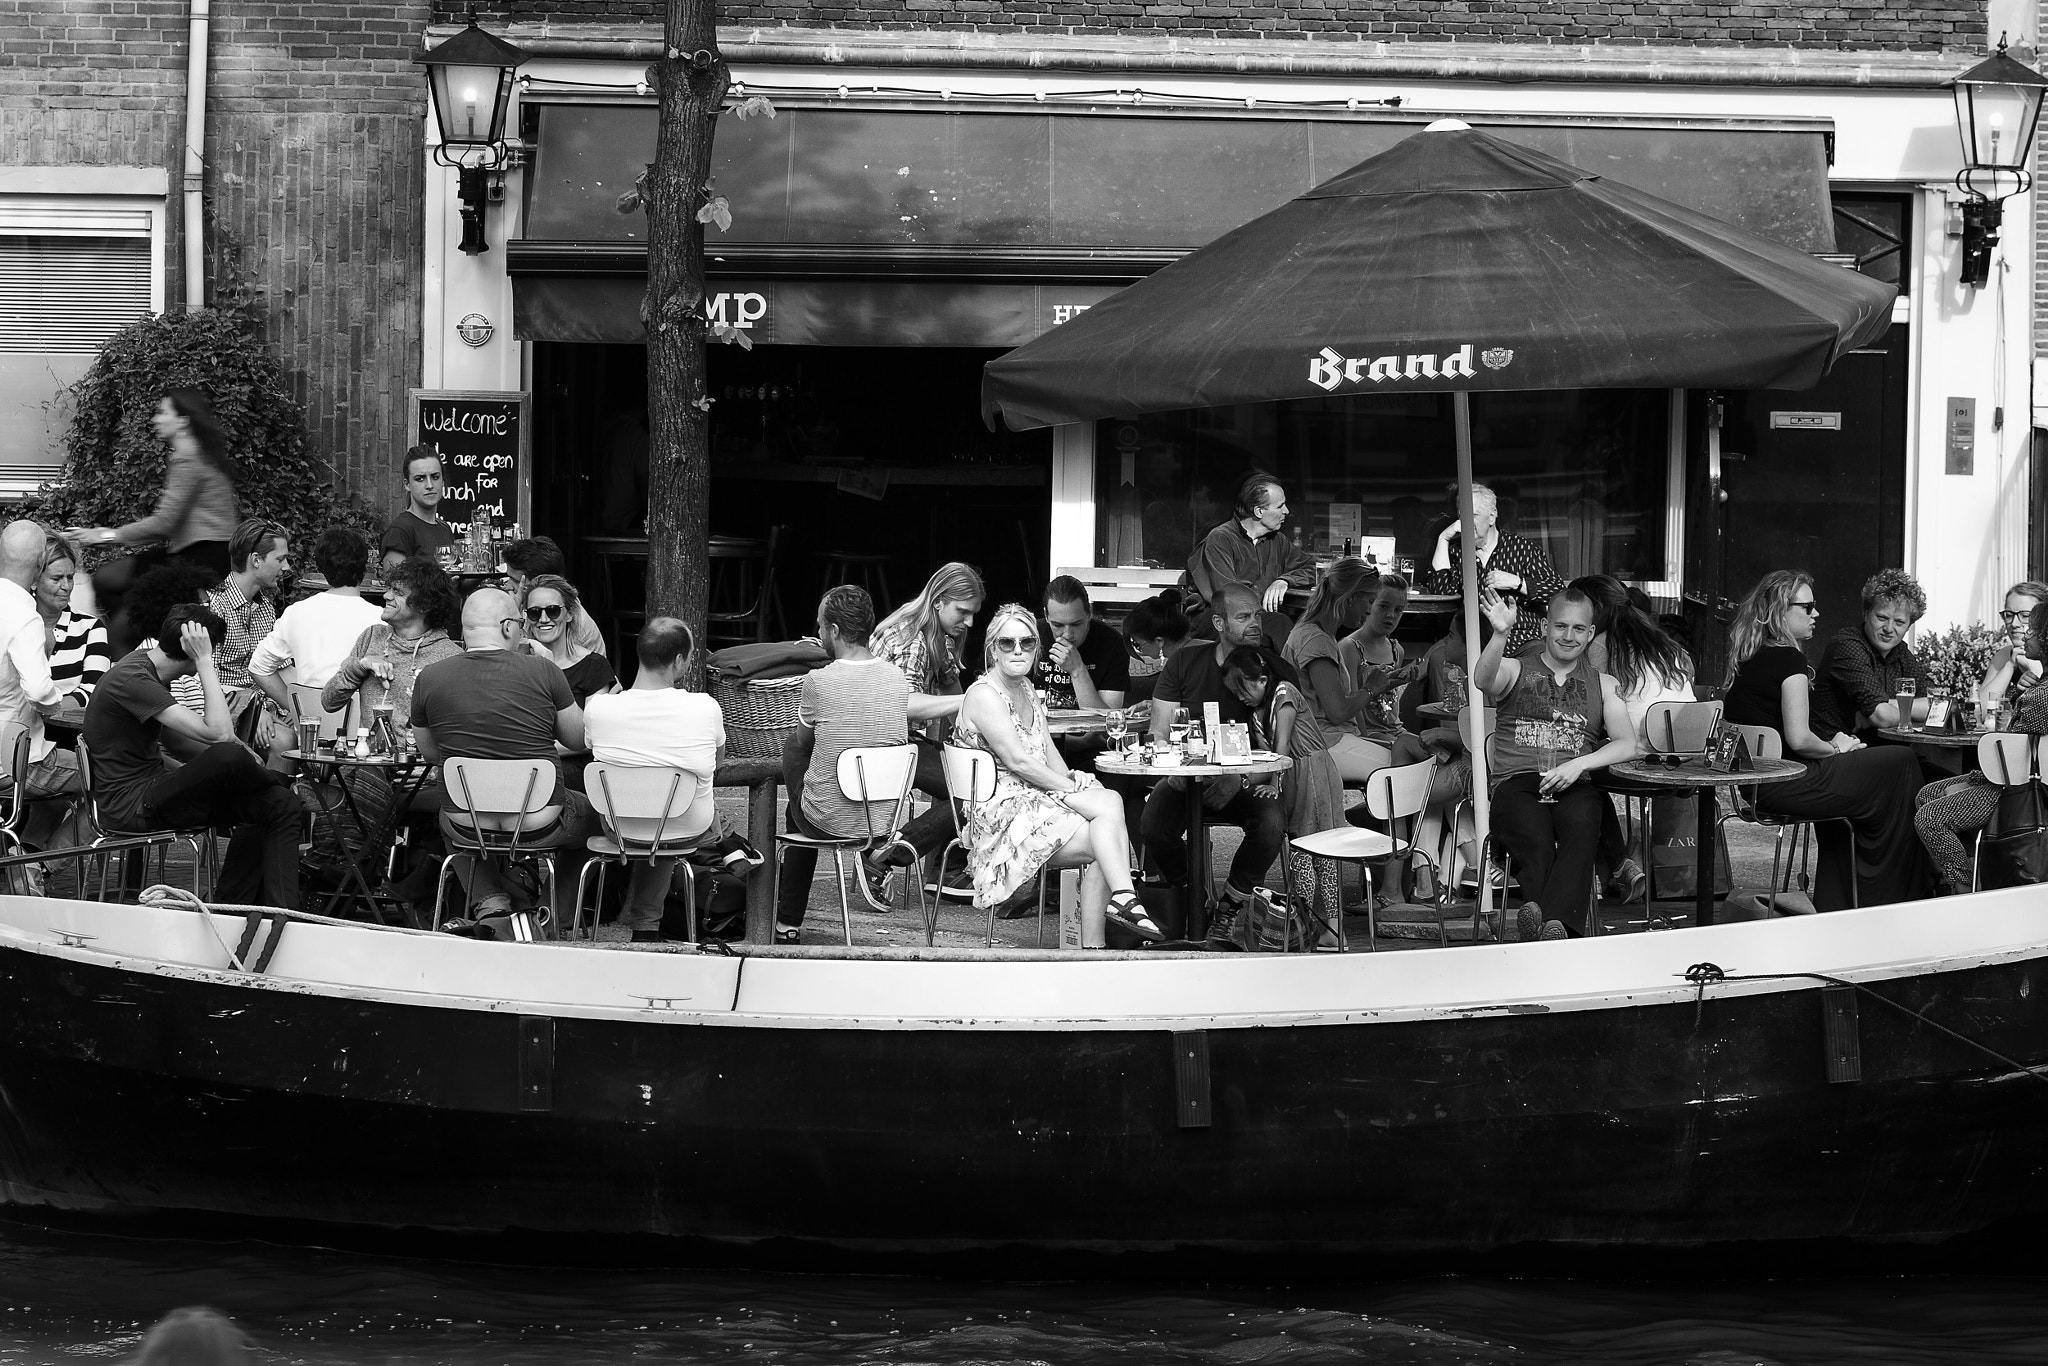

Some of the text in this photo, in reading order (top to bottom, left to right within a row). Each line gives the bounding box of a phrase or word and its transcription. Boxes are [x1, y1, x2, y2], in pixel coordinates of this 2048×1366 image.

[1308, 344, 1477, 391] Brand
[483, 454, 514, 472] open
[1667, 837, 1696, 847] ZAR
